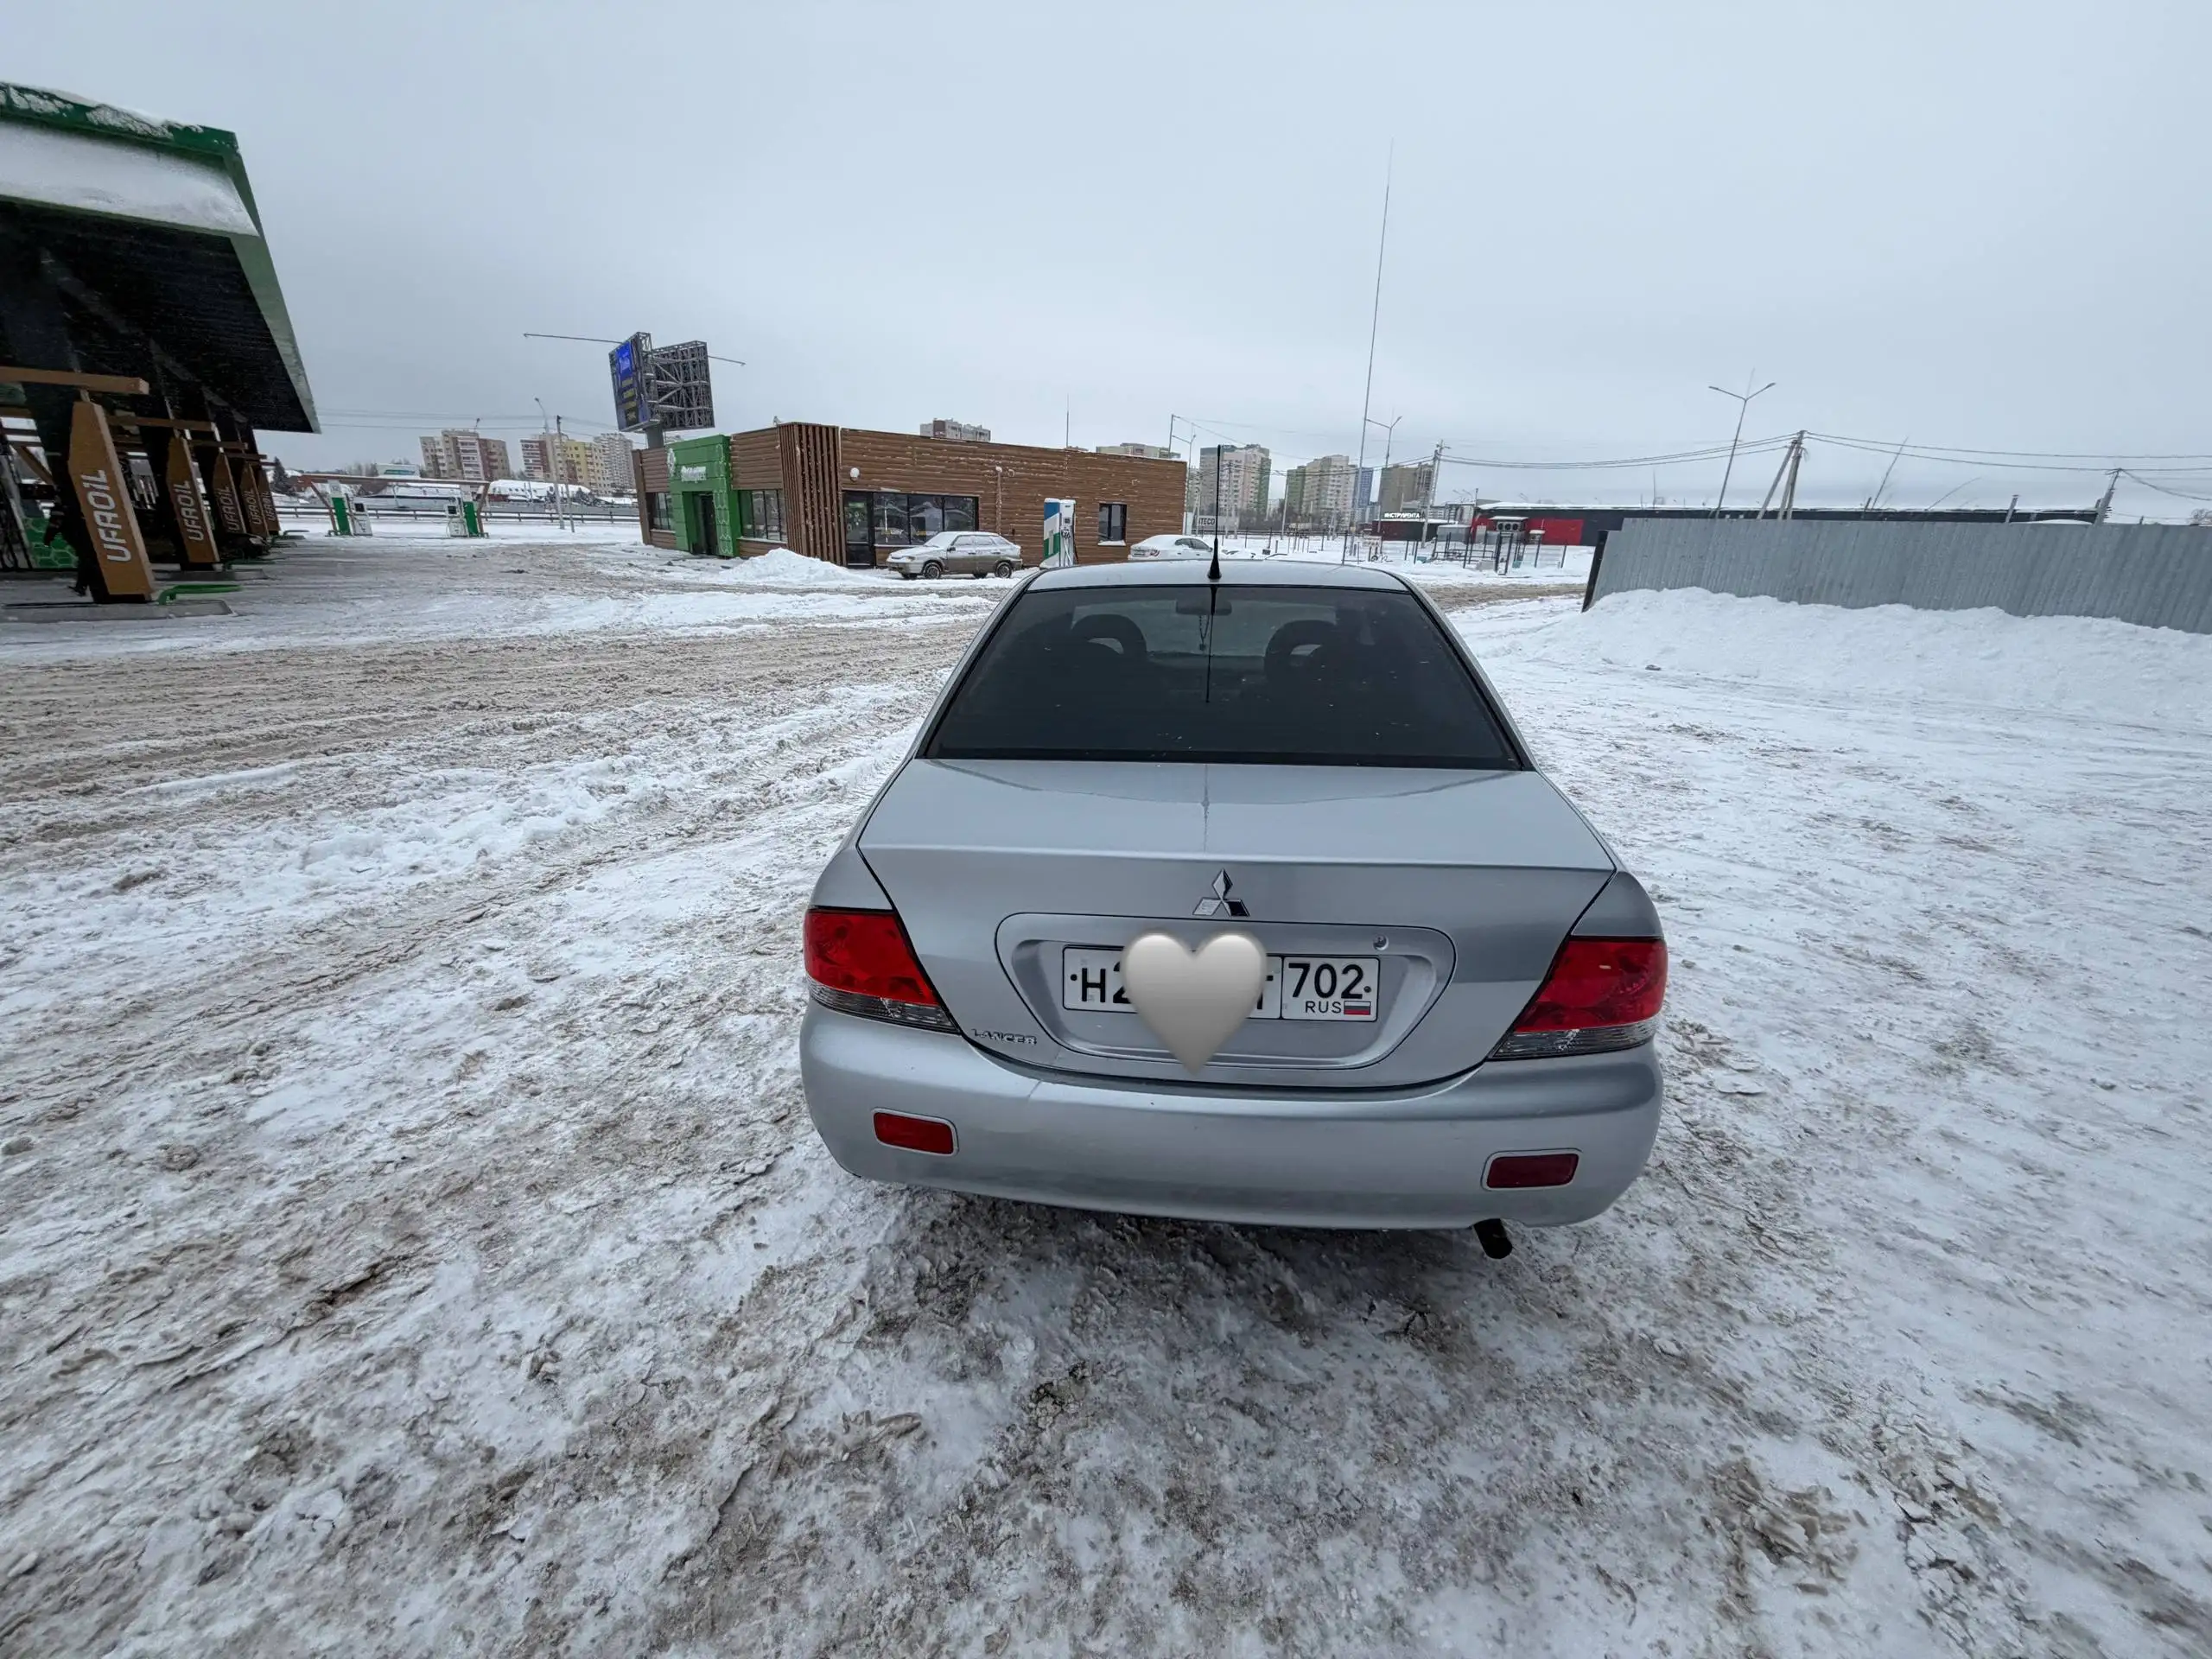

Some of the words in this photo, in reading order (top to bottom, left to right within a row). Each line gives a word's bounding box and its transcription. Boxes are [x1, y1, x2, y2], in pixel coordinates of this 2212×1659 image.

[1288, 963, 1363, 999] 702
[1305, 1001, 1342, 1014] RUS
[971, 1028, 1037, 1045] LANCER
